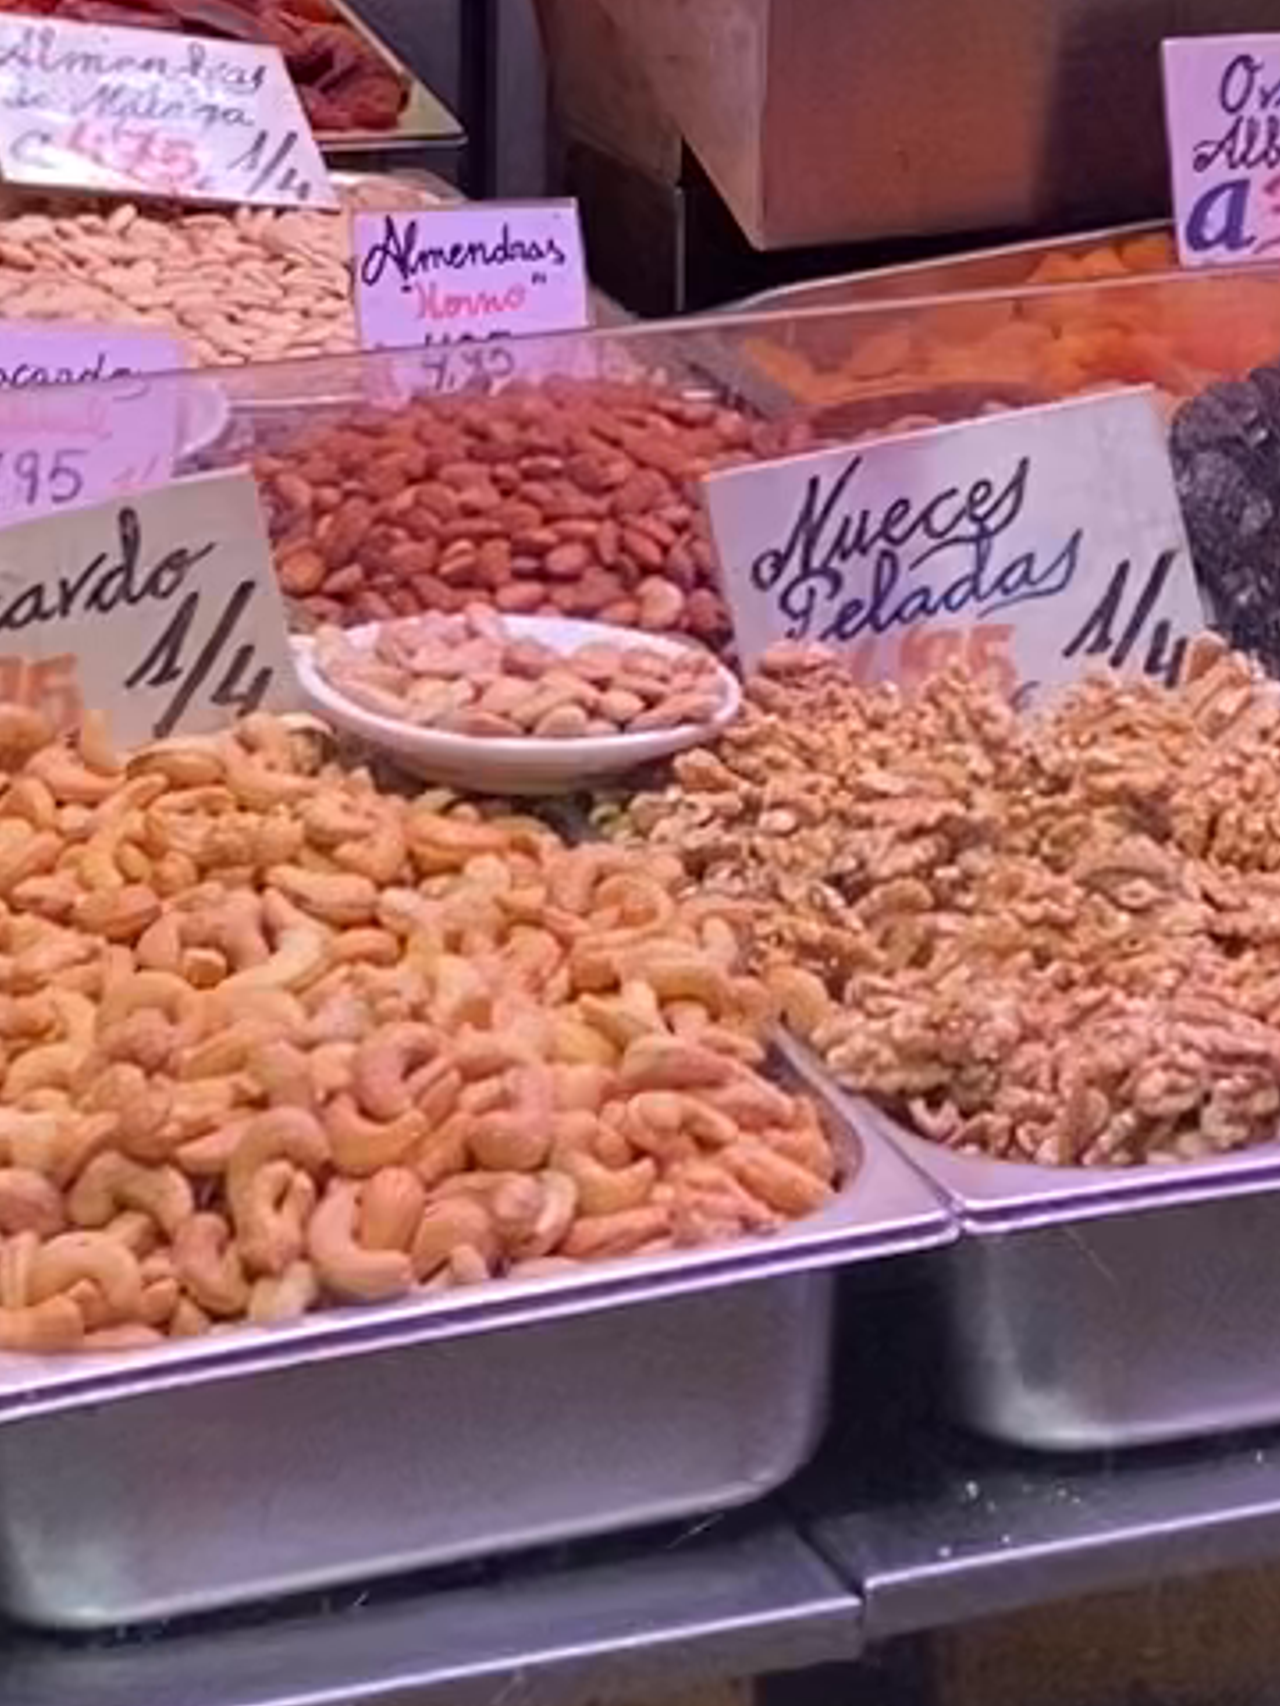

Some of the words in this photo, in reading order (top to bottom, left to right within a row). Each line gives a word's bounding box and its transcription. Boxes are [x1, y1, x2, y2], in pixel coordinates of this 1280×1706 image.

[361, 214, 567, 287] Almendras
[1185, 179, 1257, 252] a
[750, 455, 1031, 590] Nueces
[777, 526, 1084, 642] Peladas
[123, 580, 275, 739] 1/4
[1061, 548, 1189, 687] 1/4
